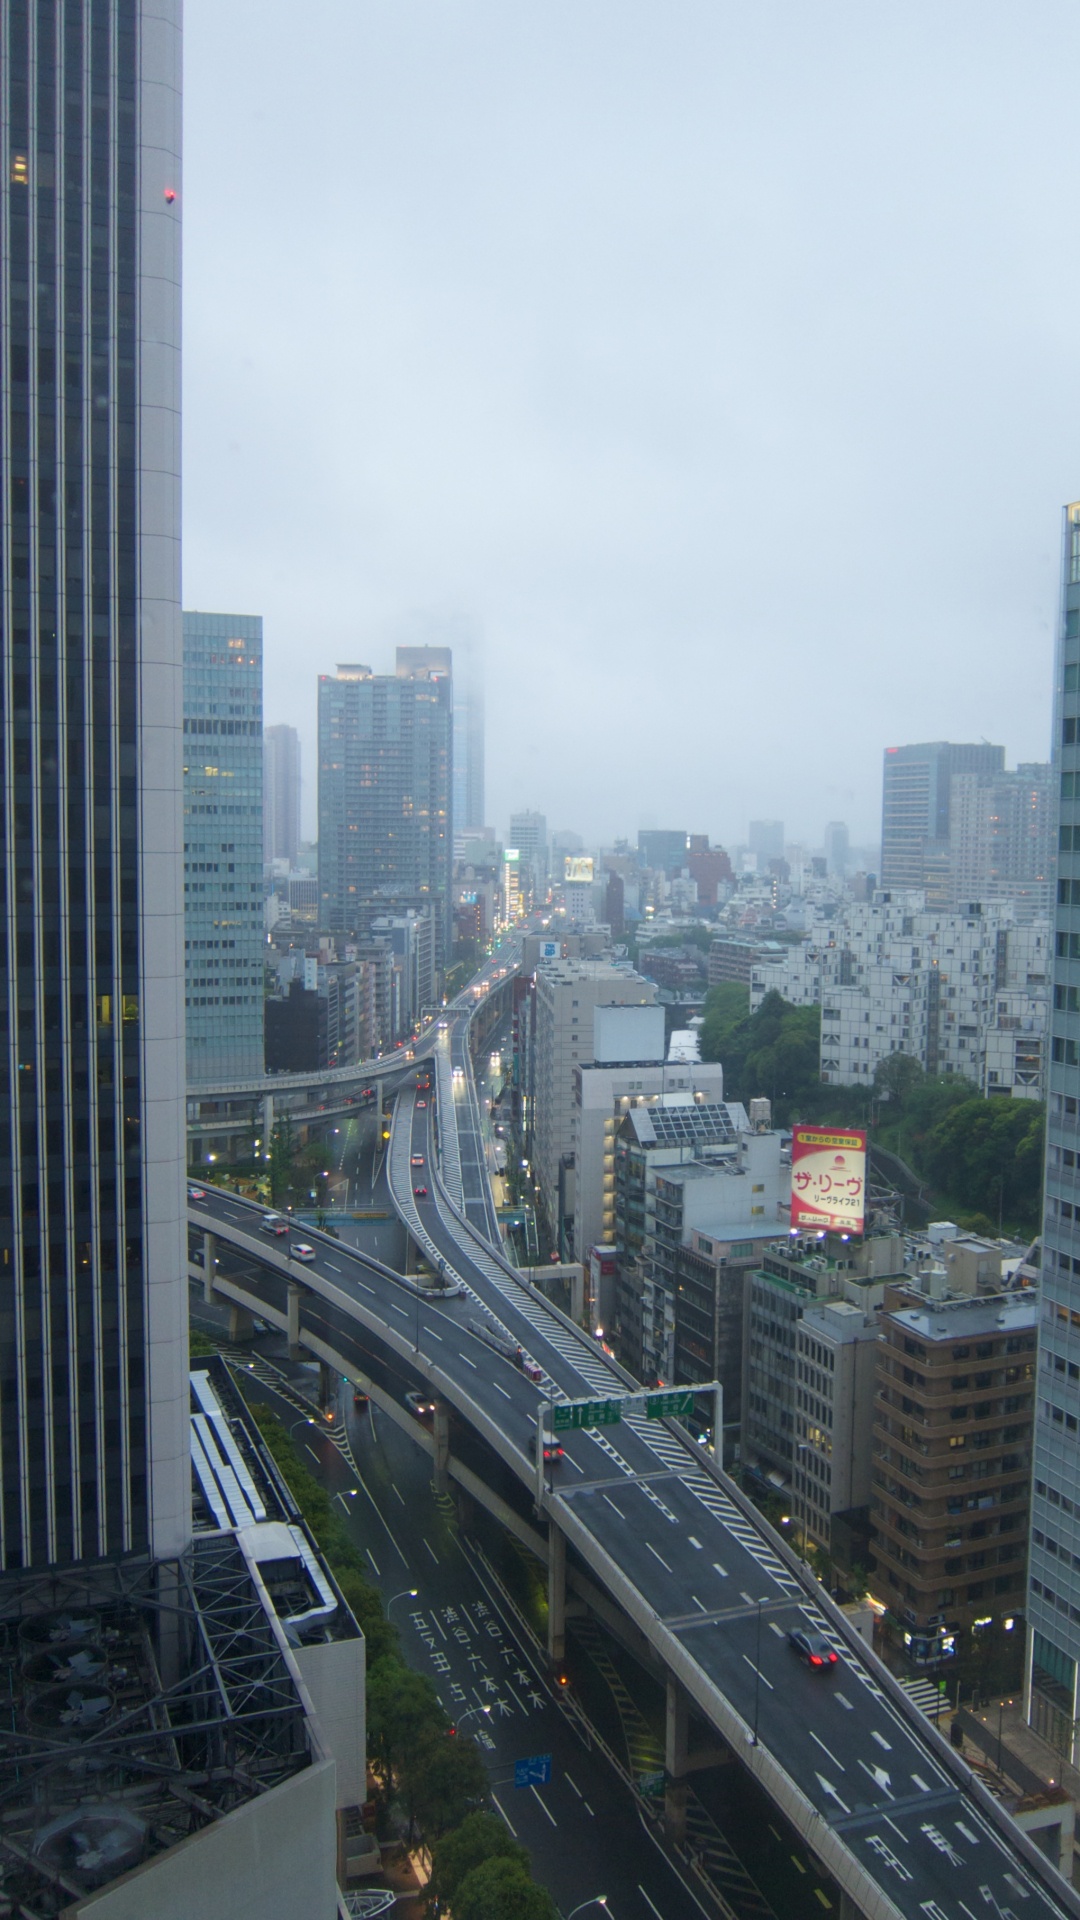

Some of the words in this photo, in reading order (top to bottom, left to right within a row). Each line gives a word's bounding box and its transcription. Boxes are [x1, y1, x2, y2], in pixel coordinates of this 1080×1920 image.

[794, 1171, 863, 1195] ザ・リーヴ
[441, 1606, 514, 1717] 渋谷・六本木
[472, 1600, 547, 1709] 渋谷・六本木
